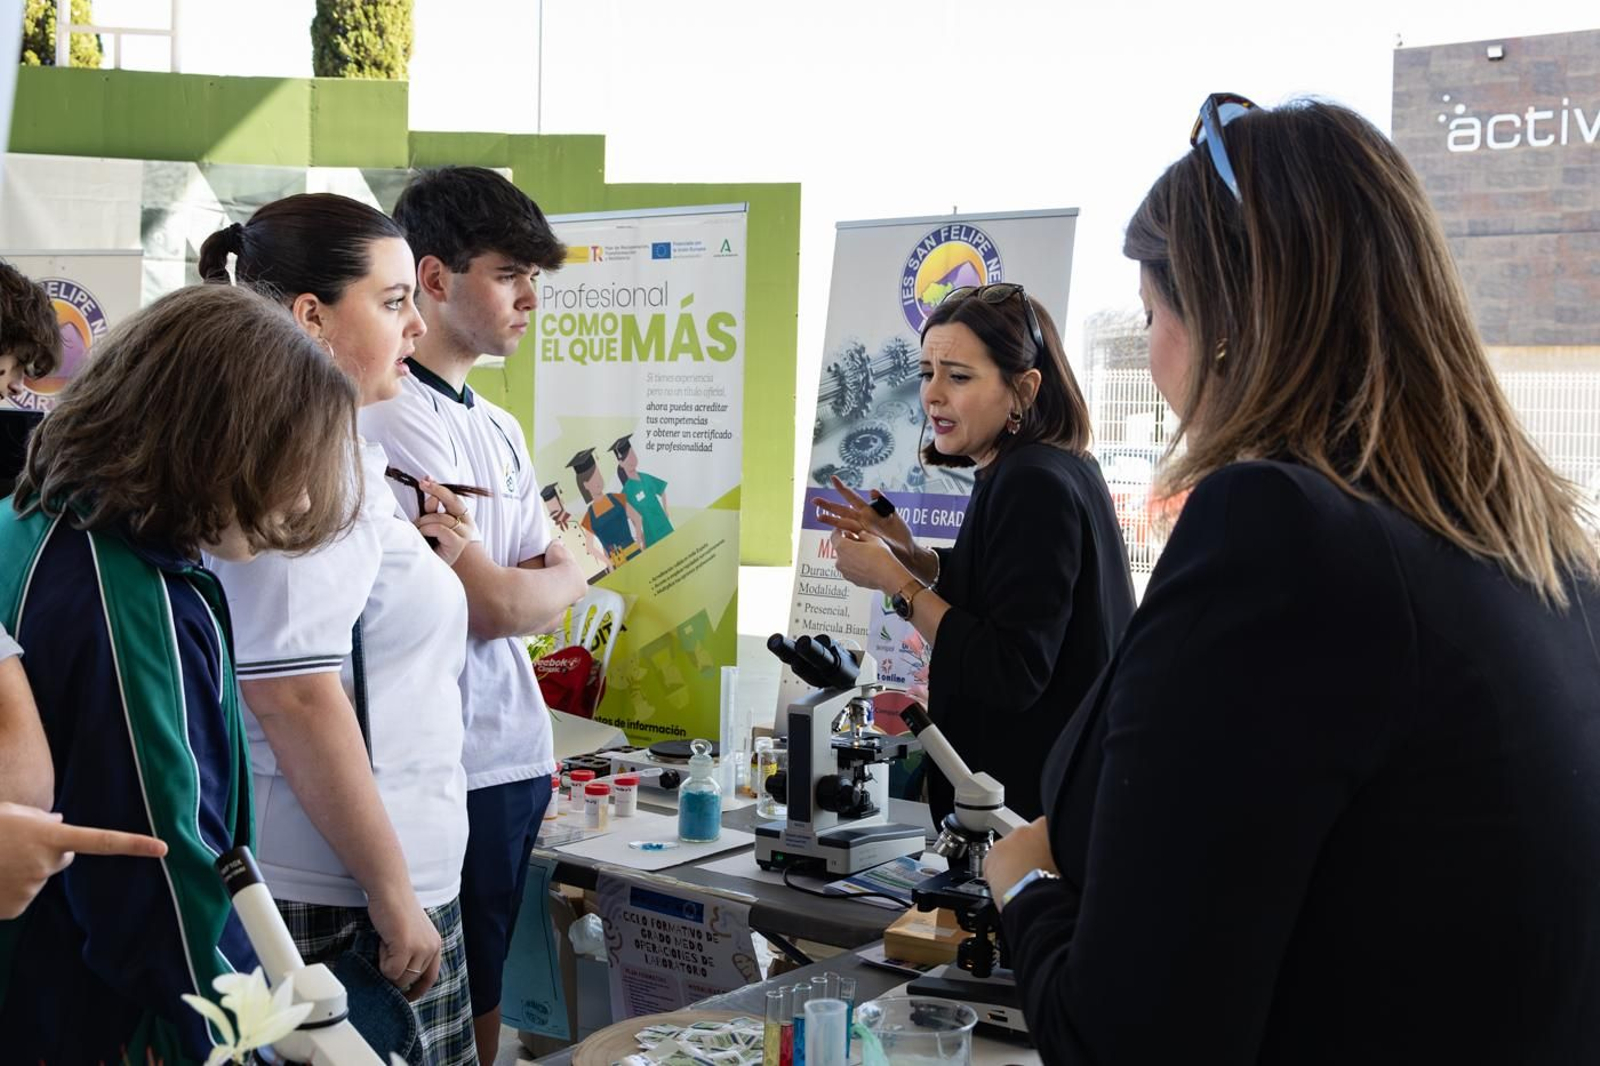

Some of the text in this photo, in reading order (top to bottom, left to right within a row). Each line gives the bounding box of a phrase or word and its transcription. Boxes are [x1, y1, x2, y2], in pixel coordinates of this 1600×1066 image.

[903, 225, 1001, 306] IES SAN FELIPE NE
[542, 280, 669, 309] Profesional
[541, 312, 619, 337] COMO
[620, 292, 738, 363] MÁS
[541, 338, 618, 365] EL QUE
[646, 401, 728, 413] ahora puedes acreditar
[646, 416, 708, 426] tus competencias
[646, 429, 652, 437] y
[653, 428, 680, 437] obtener
[692, 429, 733, 440] certificado
[645, 440, 713, 452] de profesionalidad
[912, 508, 929, 525] DE
[931, 509, 964, 527] GRAD
[804, 602, 850, 618] Presencial,
[614, 716, 626, 728] de
[627, 718, 687, 737] información
[640, 928, 671, 945] GRADO
